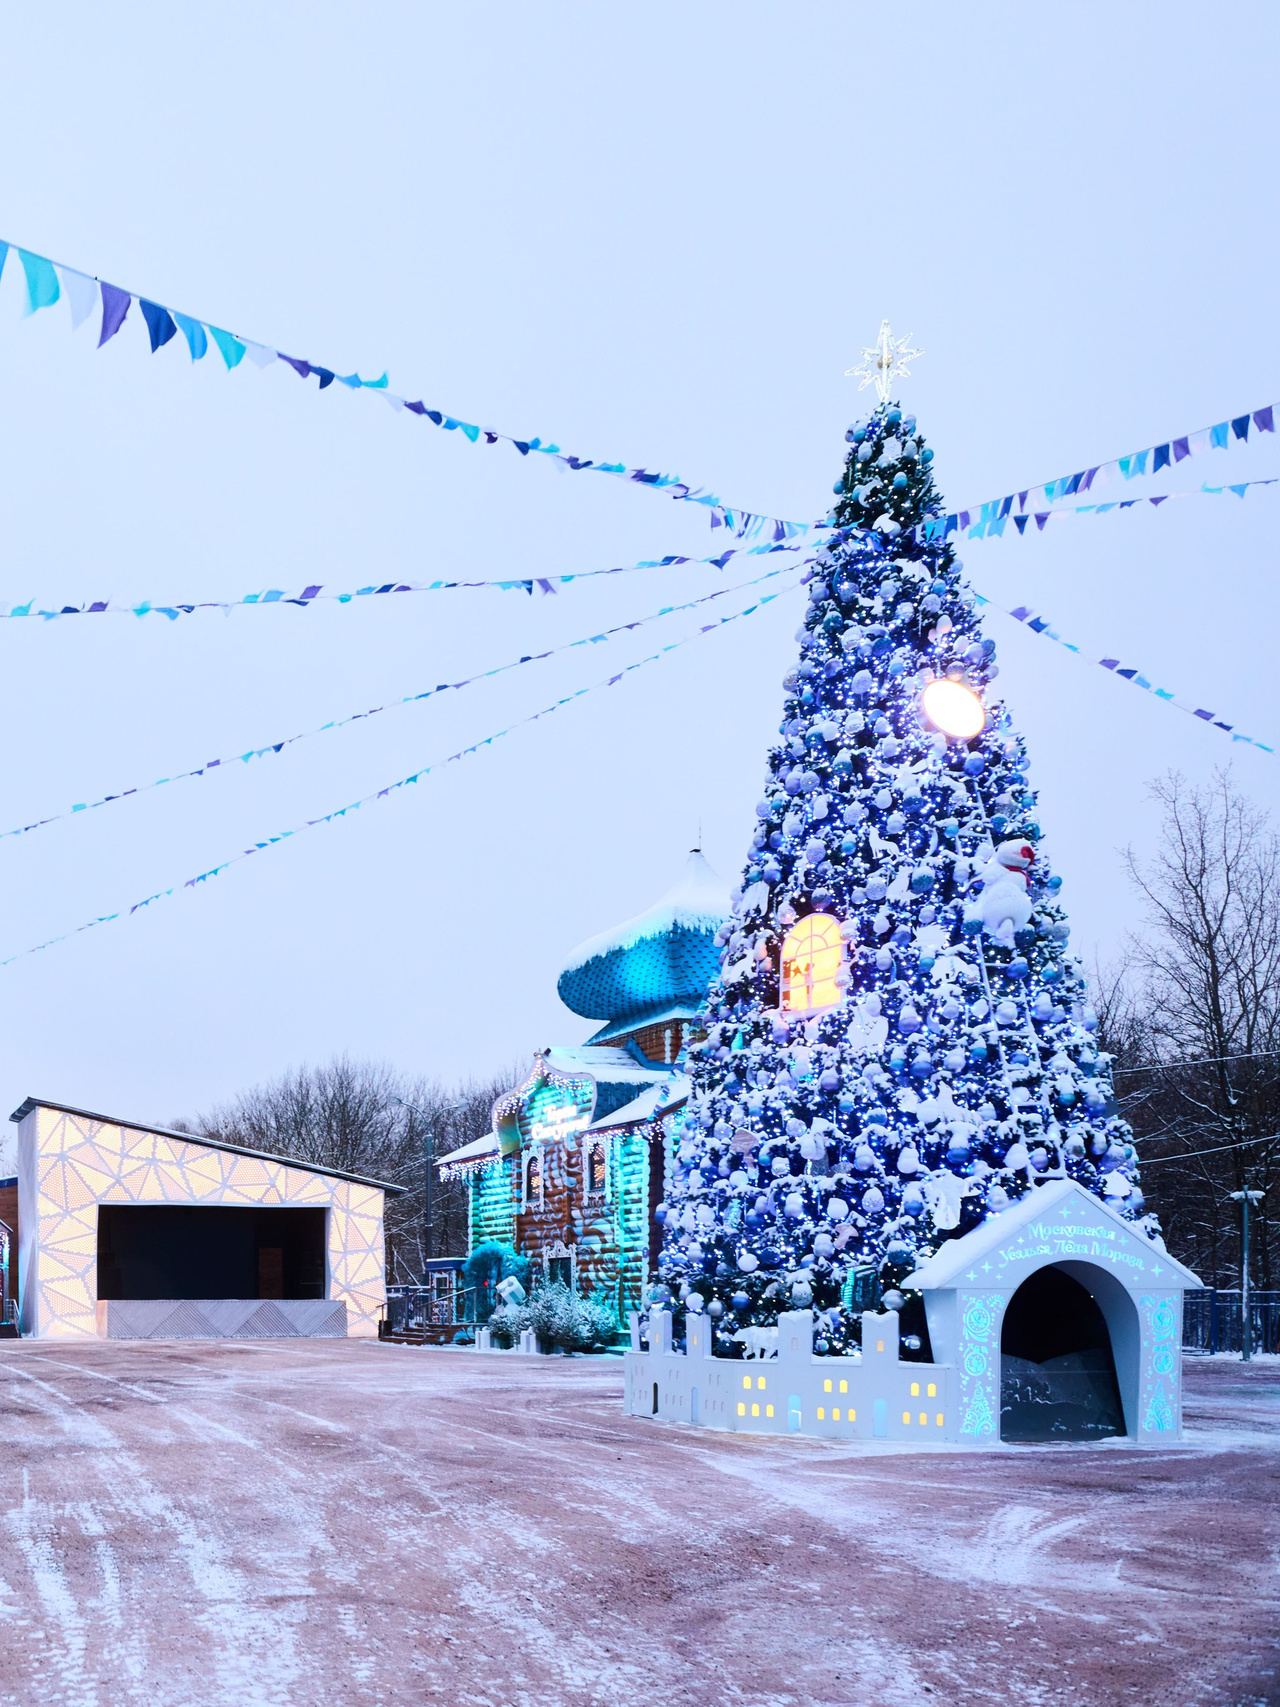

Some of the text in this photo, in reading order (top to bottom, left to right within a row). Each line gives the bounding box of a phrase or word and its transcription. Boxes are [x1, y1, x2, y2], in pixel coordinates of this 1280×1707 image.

[1027, 1222, 1116, 1241] Московская
[998, 1244, 1053, 1268] Усадьба
[1090, 1241, 1145, 1271] Мороза
